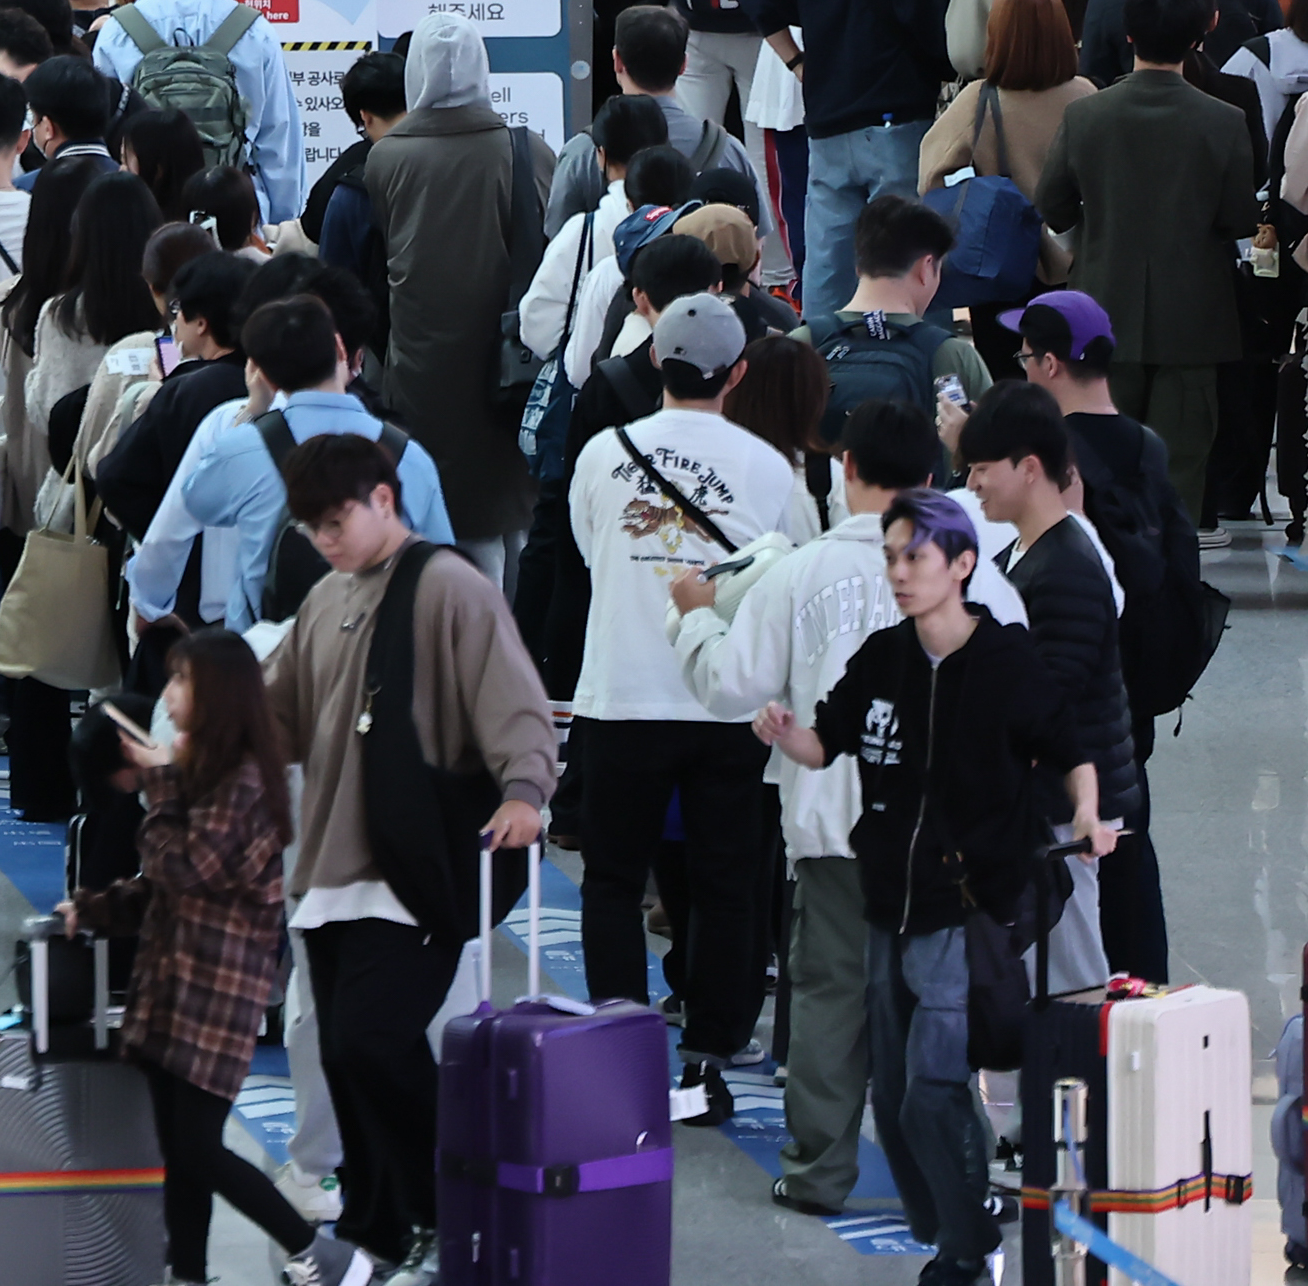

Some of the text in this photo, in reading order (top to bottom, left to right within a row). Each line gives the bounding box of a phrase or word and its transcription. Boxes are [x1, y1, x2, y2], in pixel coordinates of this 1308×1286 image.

[267, 12, 289, 20] here
[655, 447, 734, 504] FIRE JUMP
